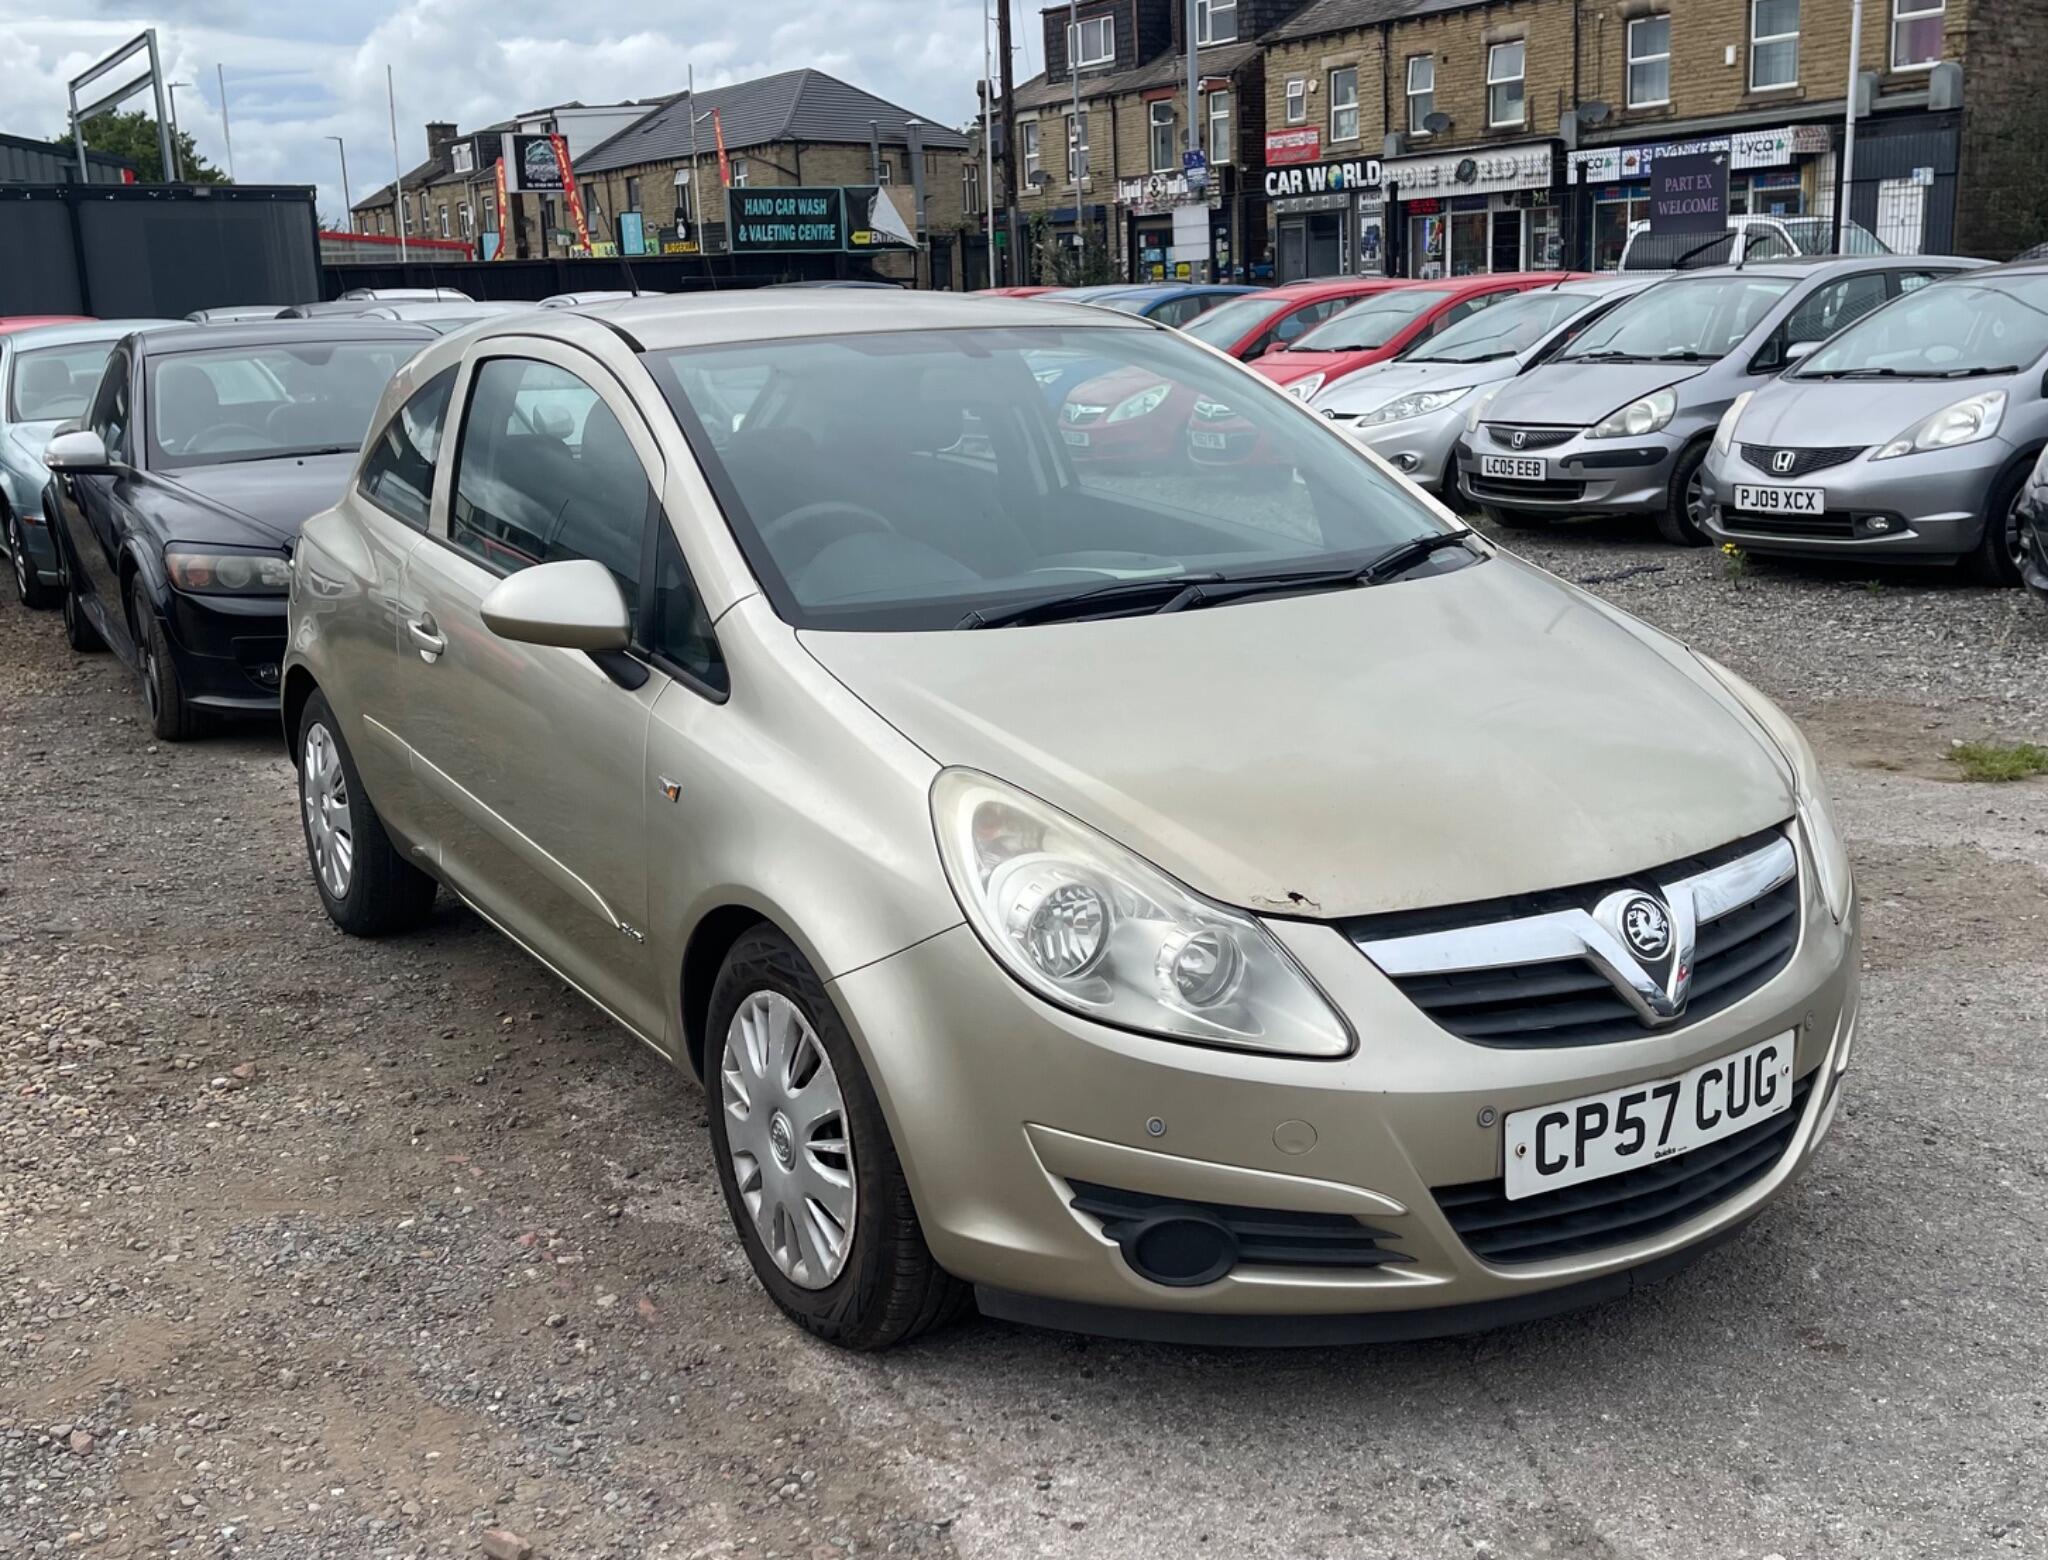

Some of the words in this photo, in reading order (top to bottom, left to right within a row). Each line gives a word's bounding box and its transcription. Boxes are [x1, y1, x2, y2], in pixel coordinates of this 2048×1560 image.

[1265, 169, 1303, 196] CAR
[1306, 160, 1381, 193] WORLD
[1665, 176, 1694, 192] PART
[1697, 174, 1712, 190] EX
[744, 199, 774, 216] HAND
[775, 199, 796, 216] CAR
[798, 198, 828, 216] WASH
[1658, 197, 1719, 215] WELCOME
[739, 227, 748, 242] &
[749, 225, 796, 241] VALETING
[799, 224, 836, 241] CENTRE
[1486, 458, 1514, 475] LC05
[1517, 461, 1541, 476] EEB
[1741, 489, 1779, 508] PJ09
[1783, 491, 1816, 510] XCX
[1535, 1080, 1682, 1176] CP57
[1696, 1046, 1778, 1131] CUG
